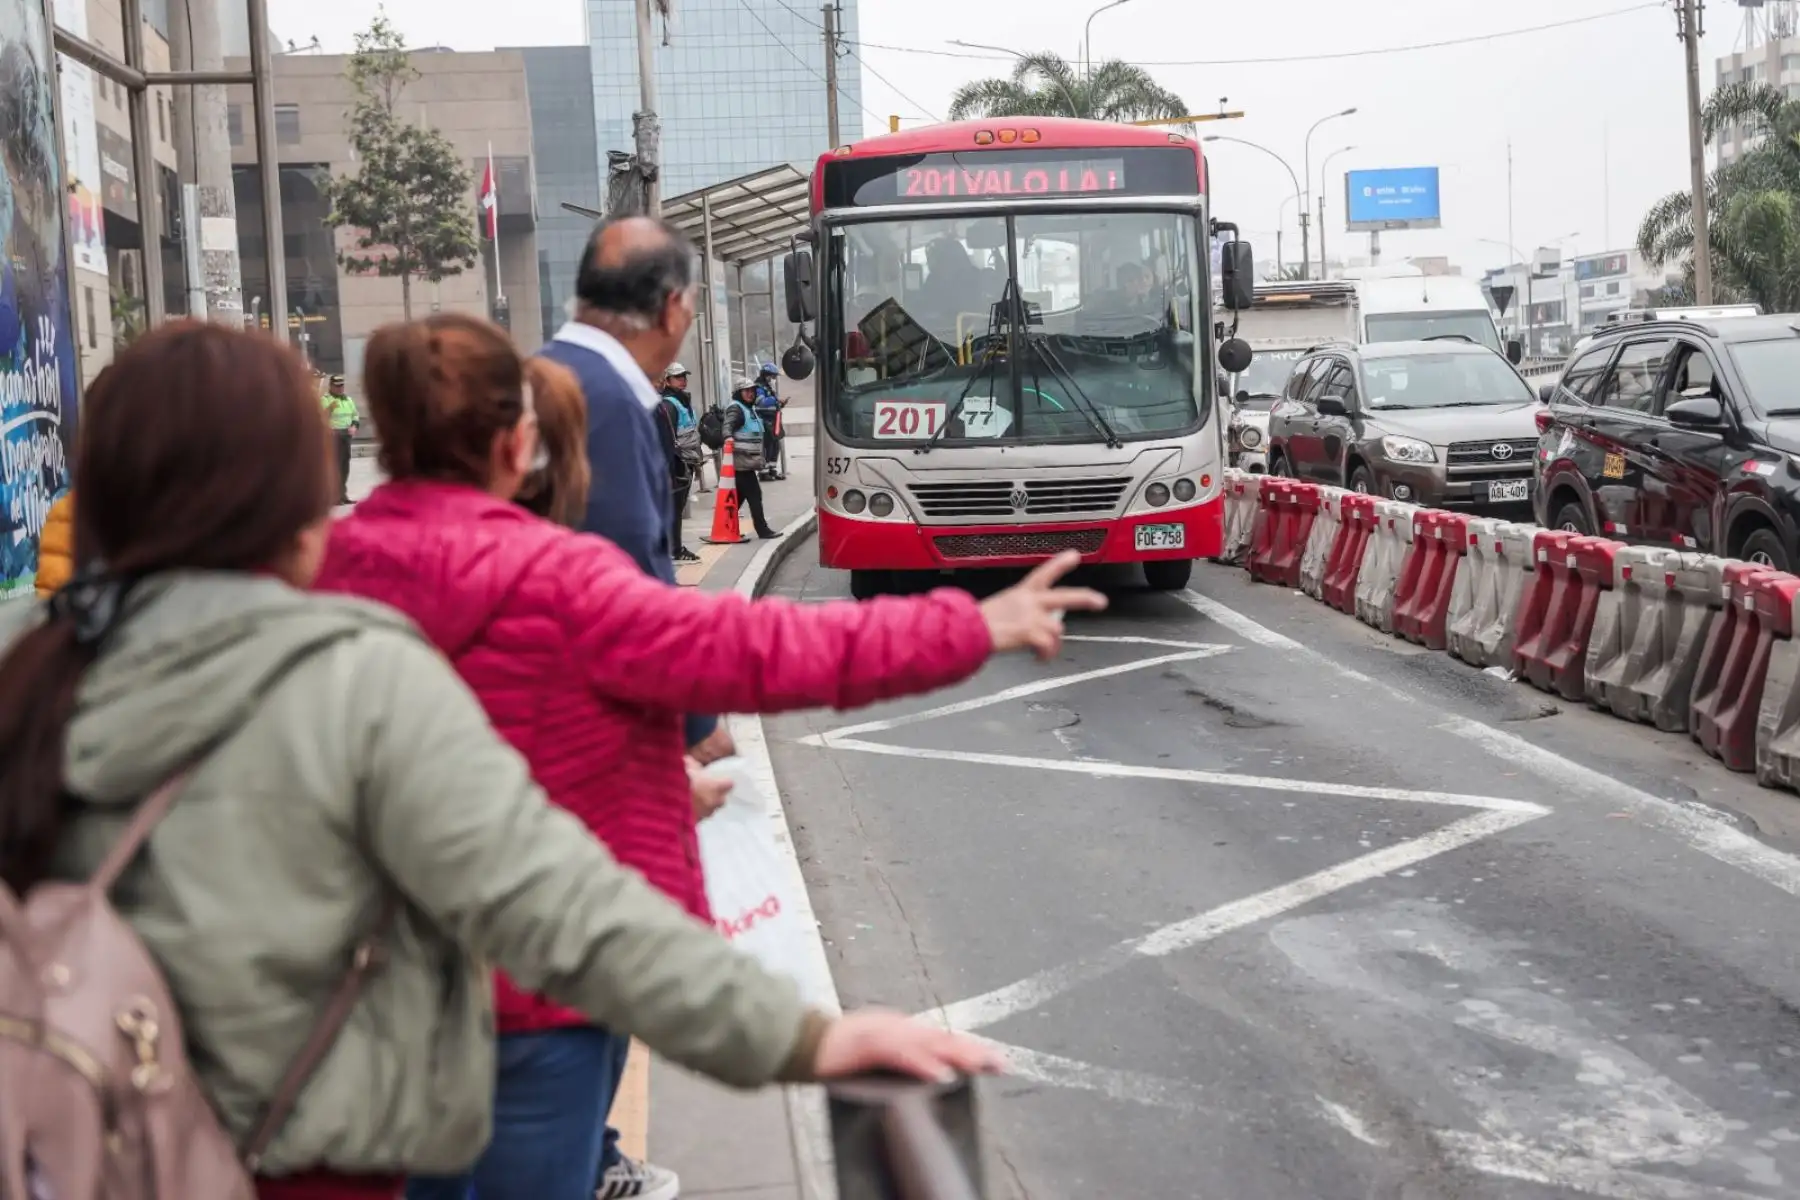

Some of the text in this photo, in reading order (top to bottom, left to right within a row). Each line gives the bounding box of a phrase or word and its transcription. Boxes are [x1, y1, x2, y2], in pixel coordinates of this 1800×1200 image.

[878, 407, 936, 435] 201
[965, 410, 994, 425] 77
[827, 457, 851, 475] 557
